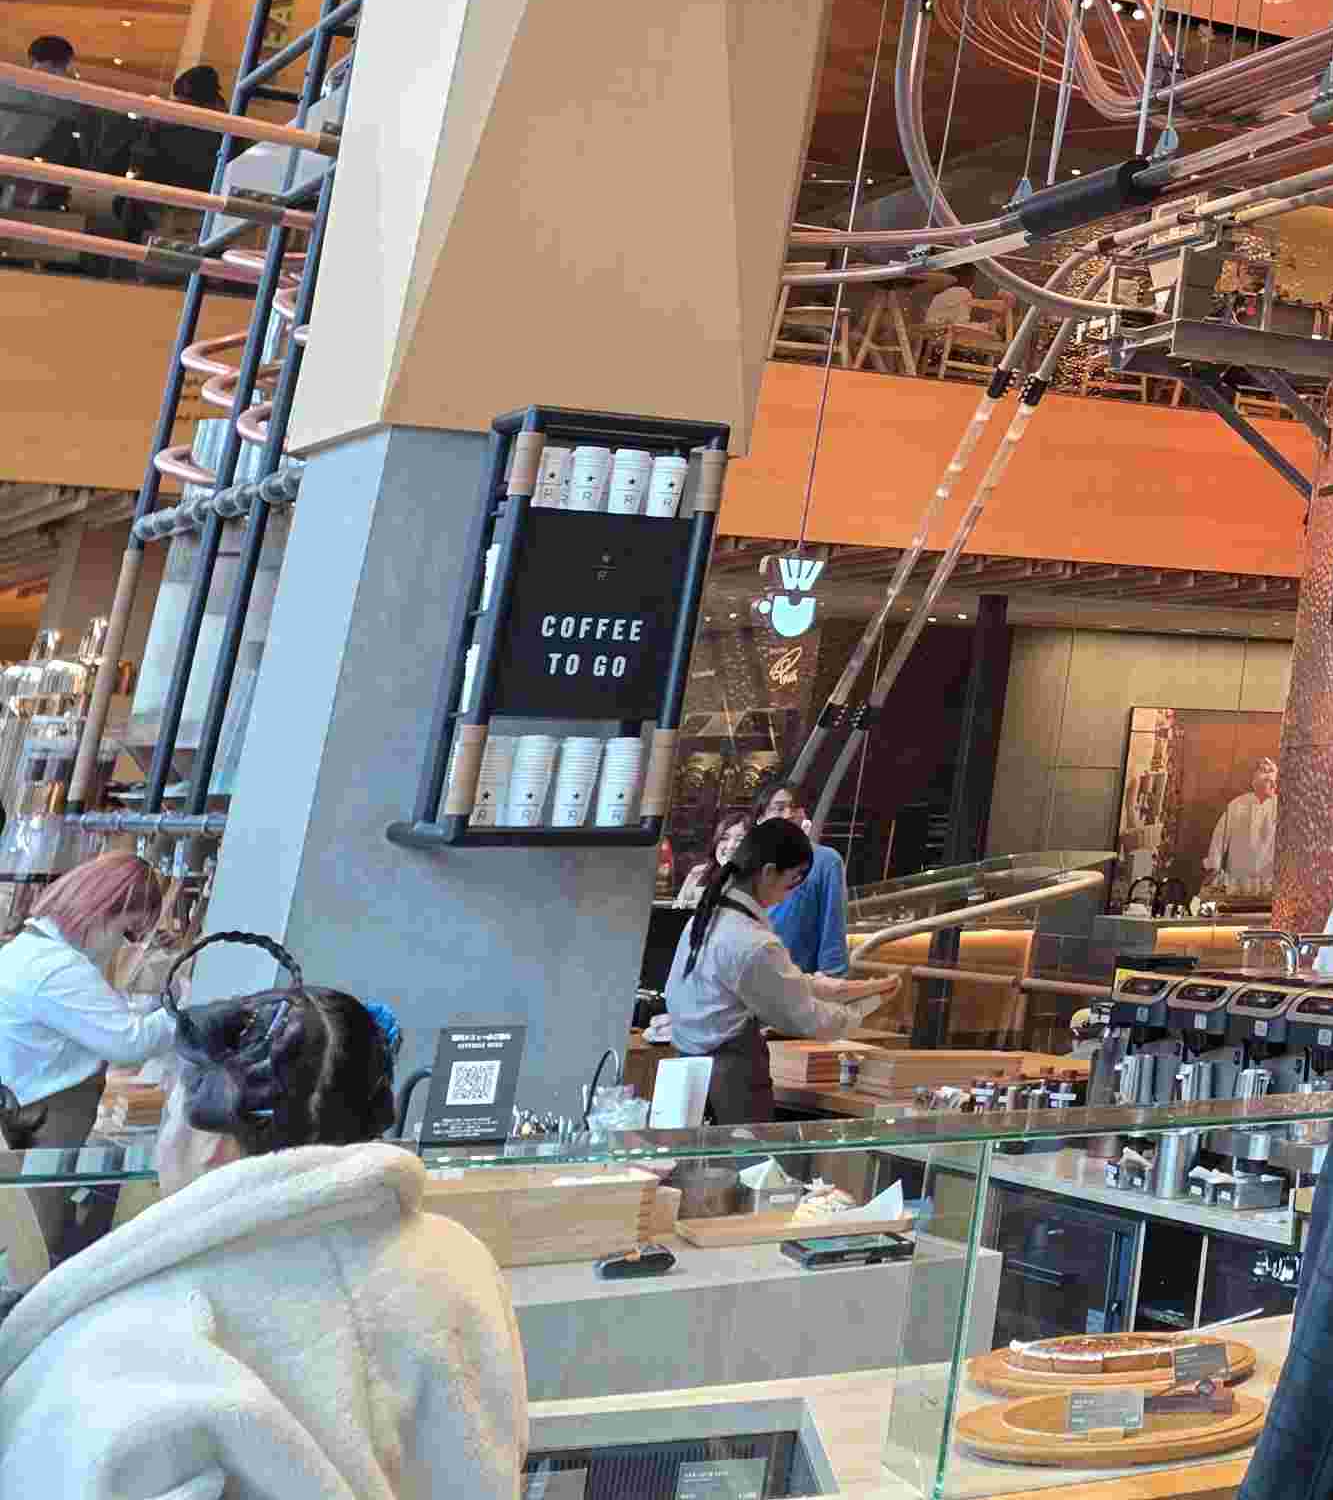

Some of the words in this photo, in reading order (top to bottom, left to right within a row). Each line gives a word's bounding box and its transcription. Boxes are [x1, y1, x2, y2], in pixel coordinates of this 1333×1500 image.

[541, 614, 644, 642] COFFEE
[548, 652, 581, 677] TO
[592, 654, 627, 678] GO
